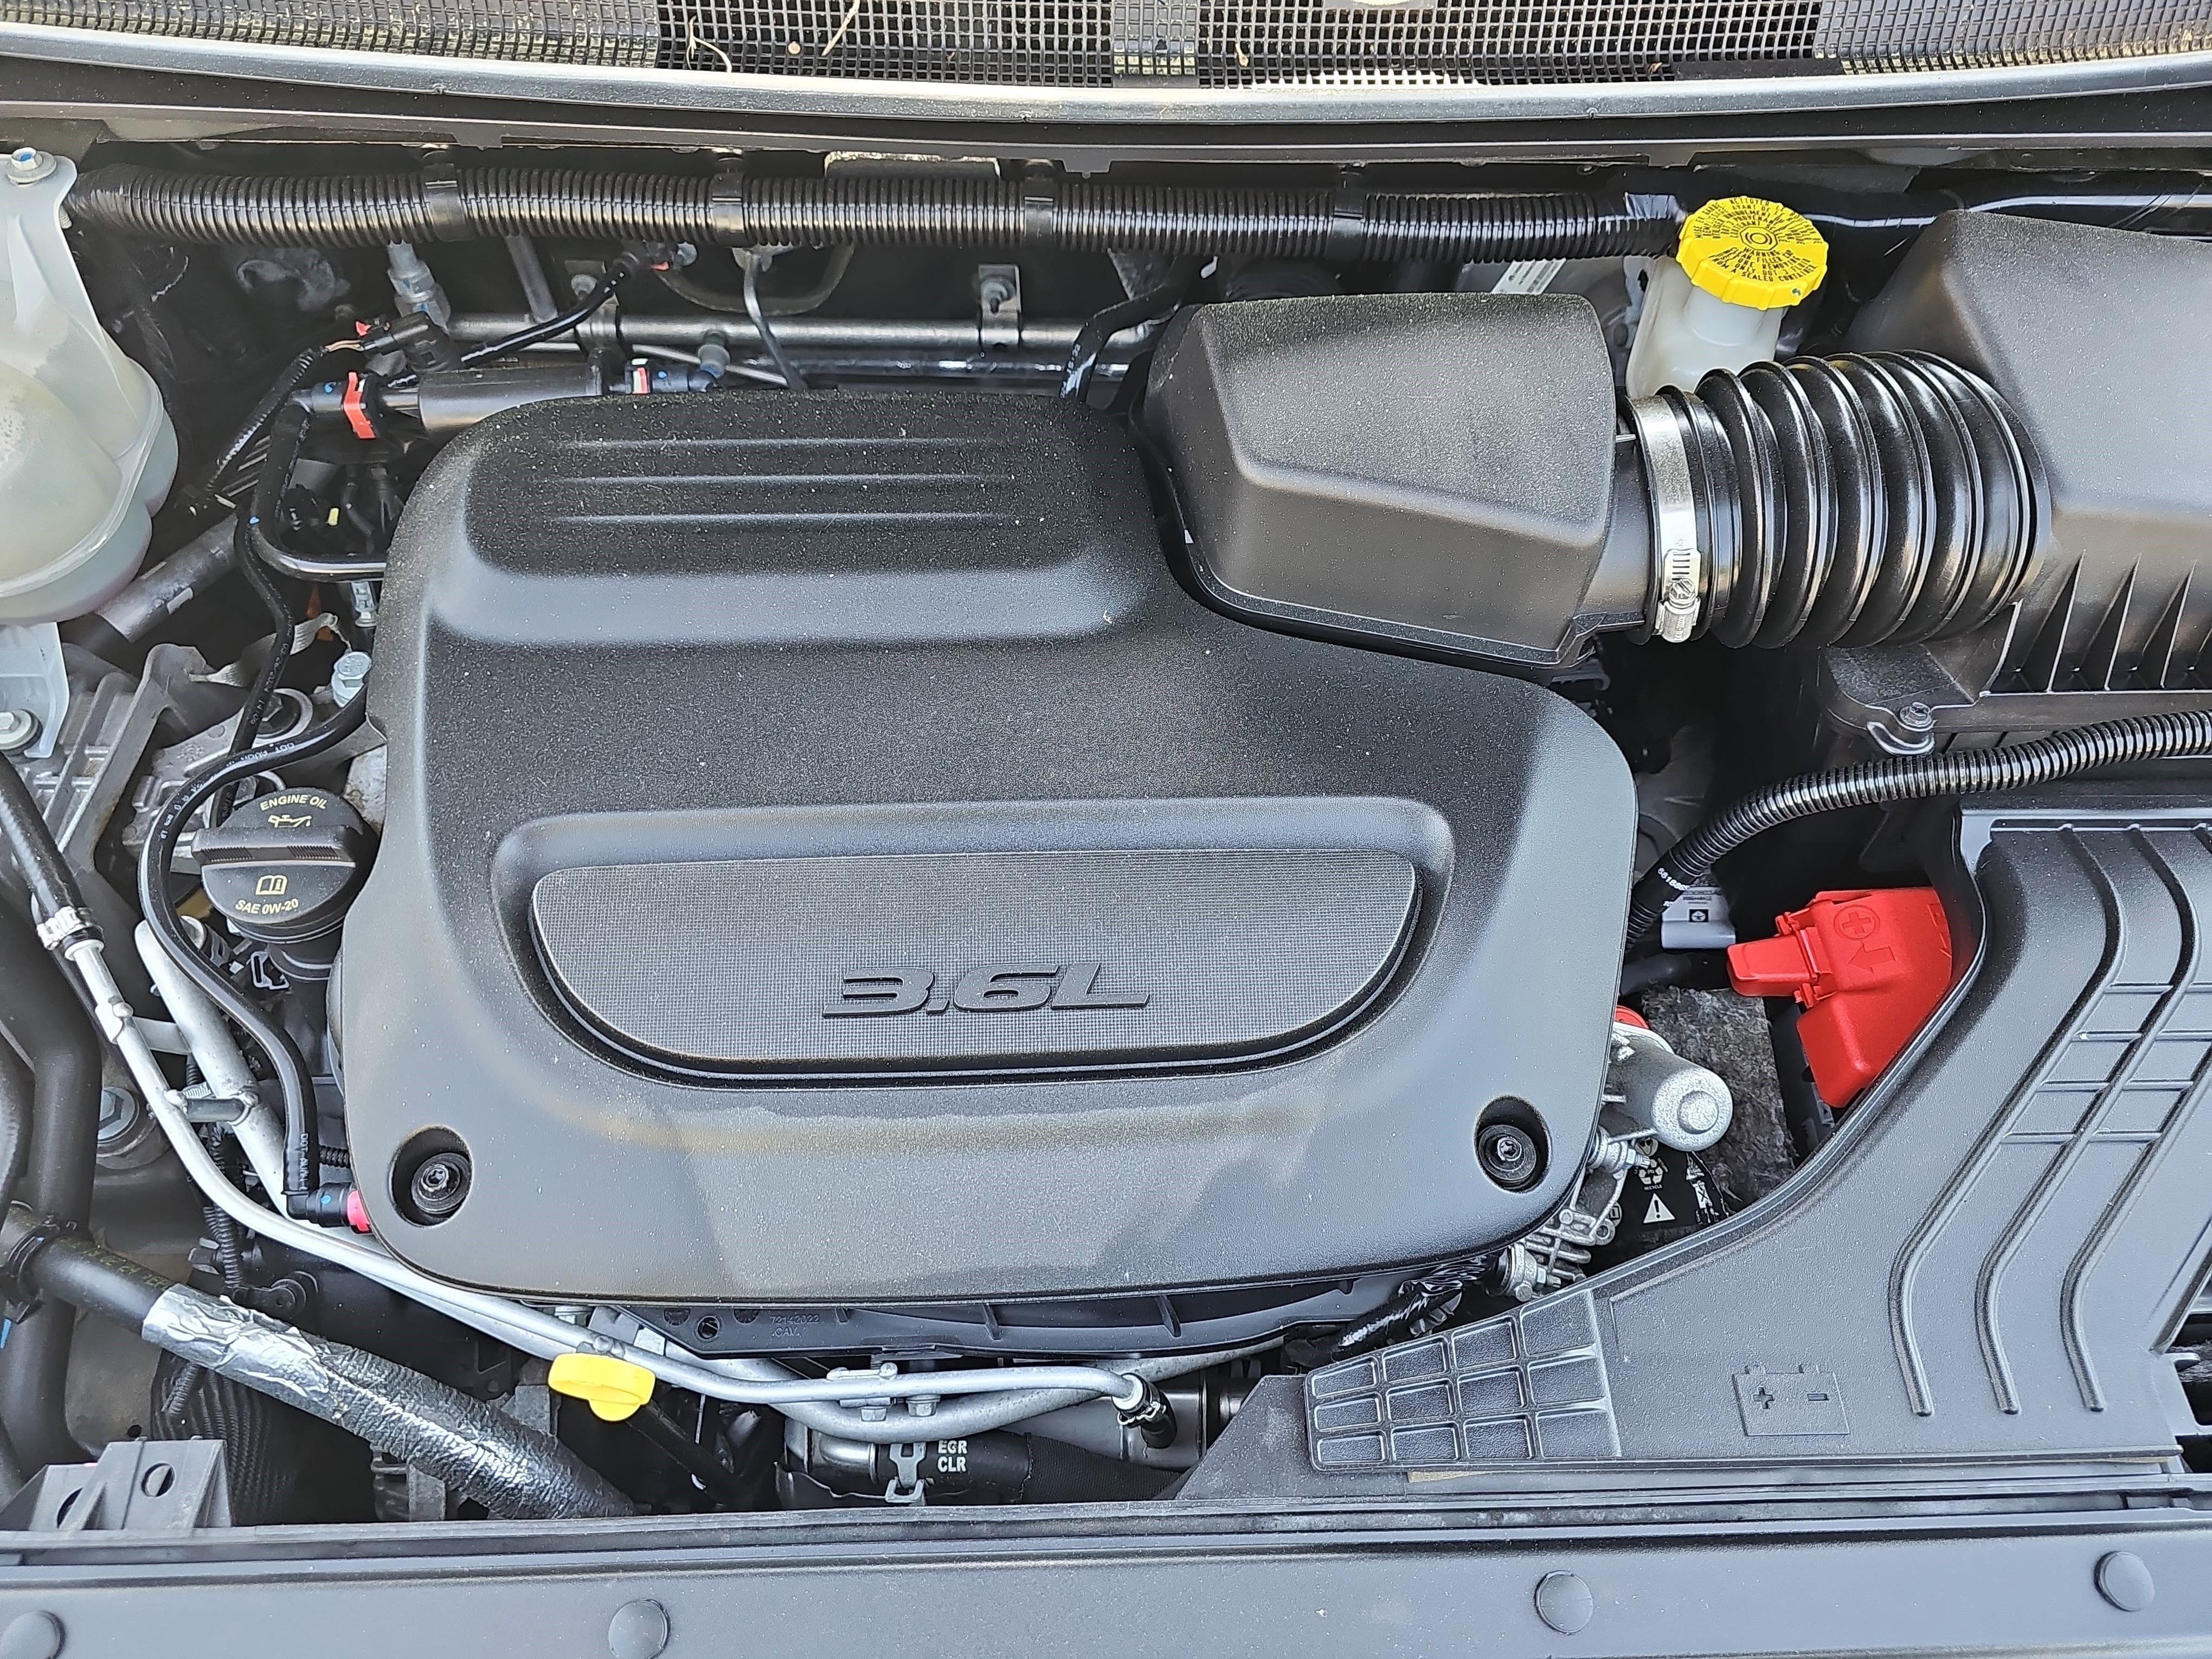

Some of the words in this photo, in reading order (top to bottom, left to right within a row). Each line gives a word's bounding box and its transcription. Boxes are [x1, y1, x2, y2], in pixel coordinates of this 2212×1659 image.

[1734, 263, 1756, 273] ONLY
[1741, 271, 1773, 281] SEALED
[260, 794, 308, 811] ENGINE
[309, 795, 329, 809] OIL
[235, 898, 260, 915] SAE
[262, 898, 300, 915] 0W-20
[821, 963, 1150, 1018] 3.6L
[938, 1440, 968, 1454] EGR
[937, 1456, 967, 1472] CLR
